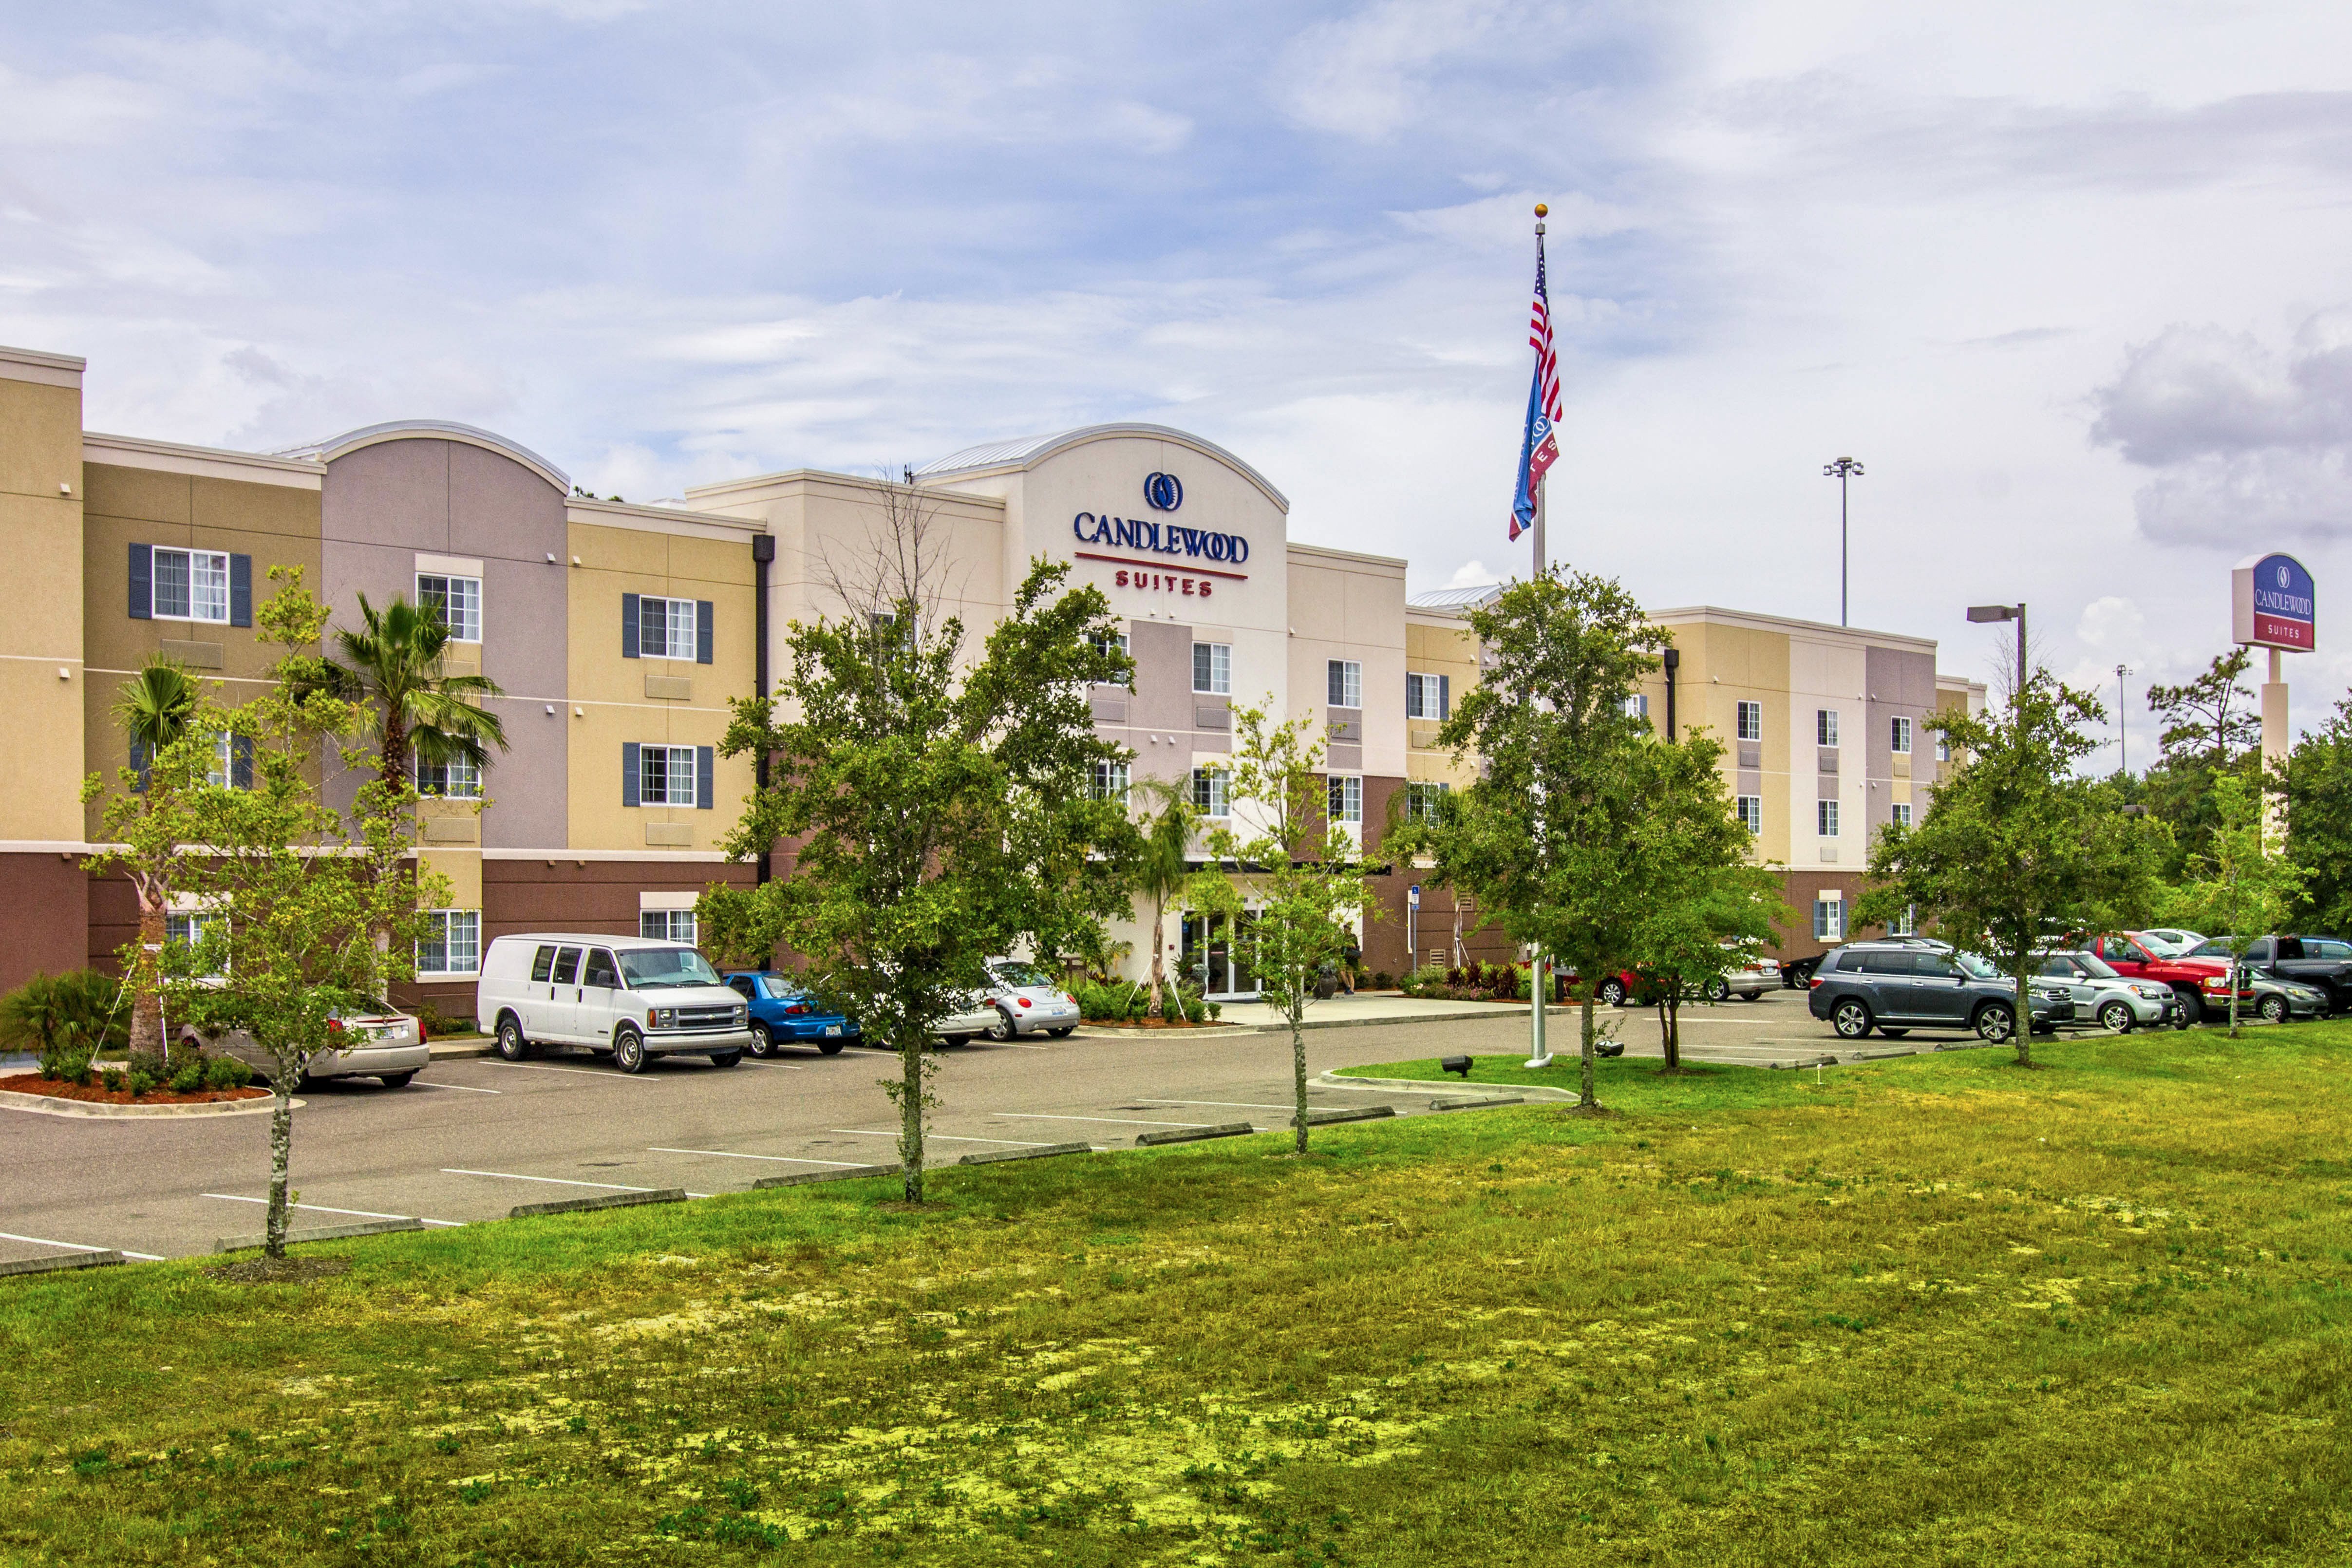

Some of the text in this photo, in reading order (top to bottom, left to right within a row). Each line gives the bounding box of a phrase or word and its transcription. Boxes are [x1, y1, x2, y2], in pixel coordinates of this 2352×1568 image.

[1530, 440, 1557, 472] TES
[1074, 512, 1249, 563] CANDLEWOOD
[1115, 570, 1212, 597] SUITES
[2255, 588, 2311, 615] CANDLEWOOD
[2268, 624, 2299, 639] SUITES
